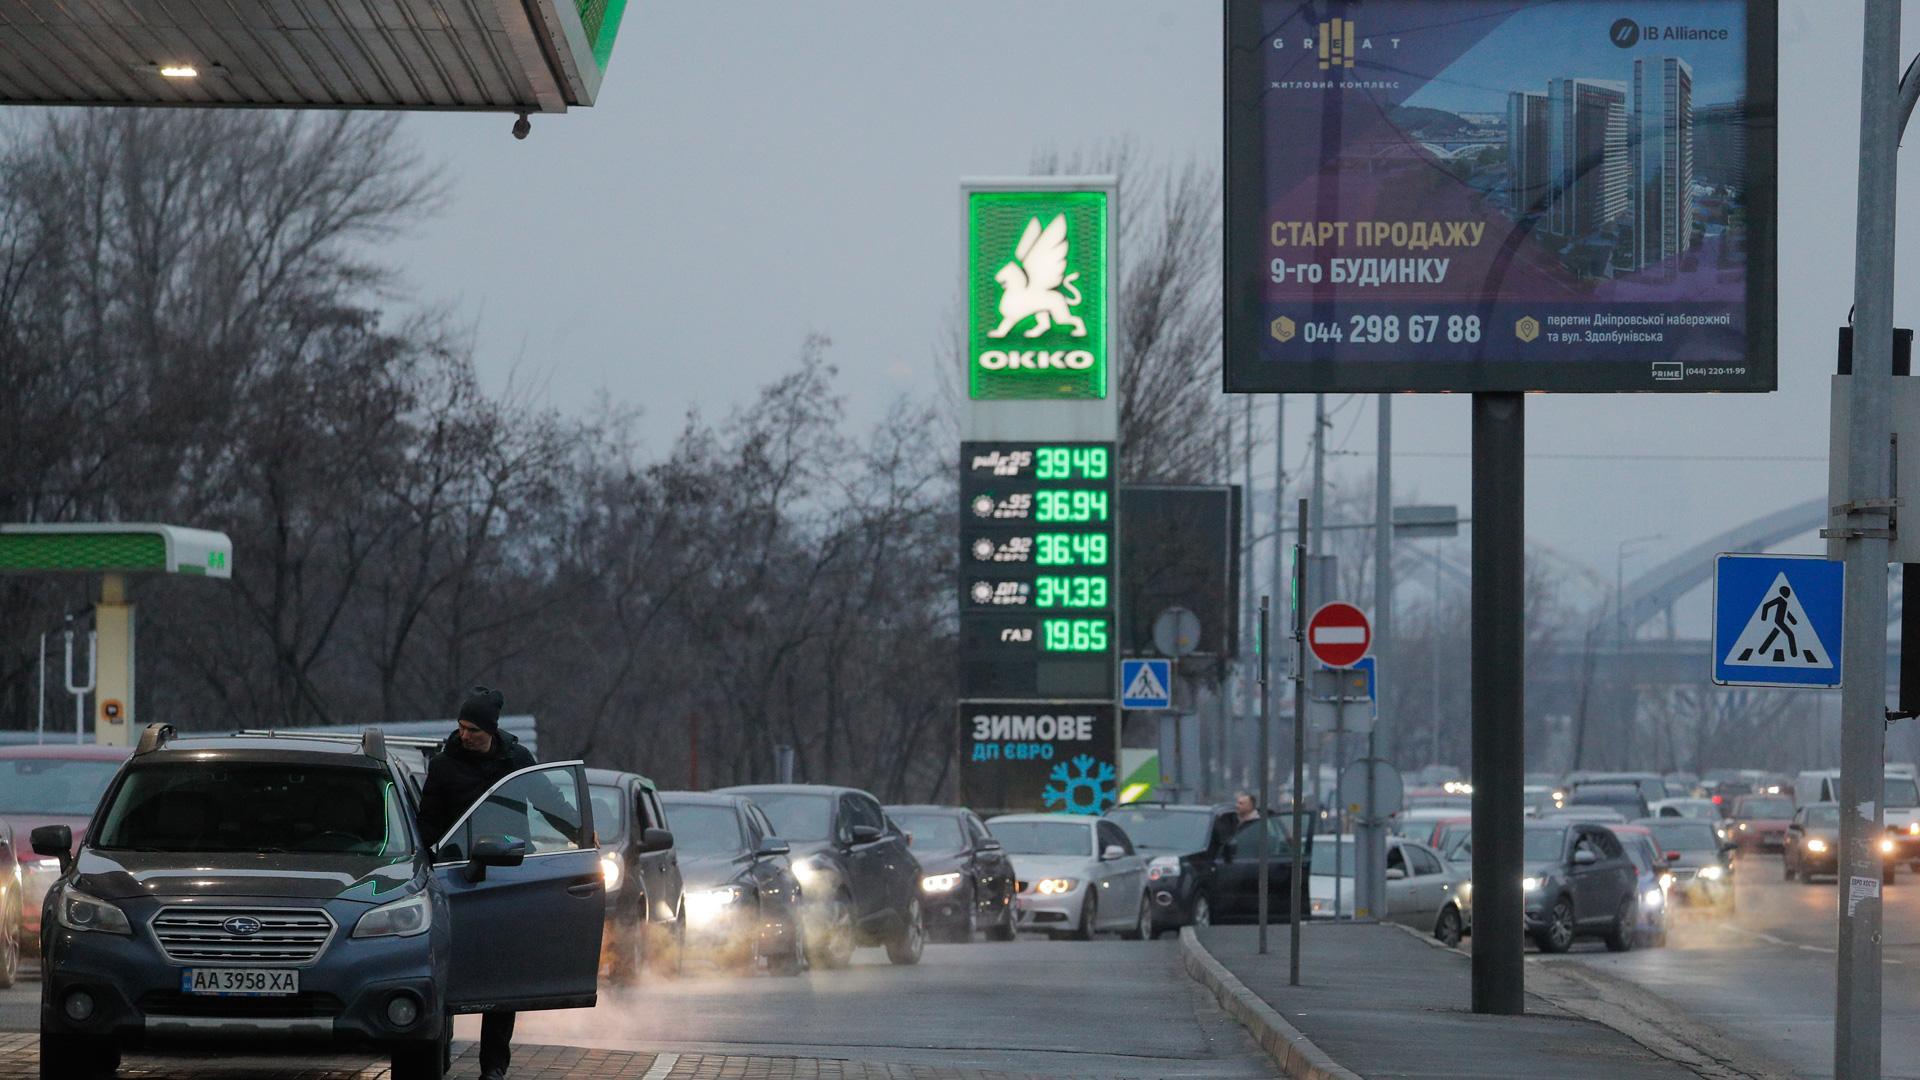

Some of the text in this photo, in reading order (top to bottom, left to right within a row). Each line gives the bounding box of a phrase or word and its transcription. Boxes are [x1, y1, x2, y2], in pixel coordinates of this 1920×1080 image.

[1643, 26, 1729, 40] IB Alliance
[1271, 81, 1399, 89] ЖИТЛОВИЙ КОМПЛЕКС
[1271, 221, 1485, 250] СТАРТ ПРОДАЖУ
[1271, 258, 1449, 287] 9-го БУДИНКУ
[1304, 315, 1481, 343] 044 298 67 88
[1547, 313, 1730, 326] перетин Дніпровської набережної
[1547, 330, 1663, 344] та вул. Здолбунівська
[1686, 367, 1746, 376] (044) 220-11-99
[1036, 491, 1107, 521] 36.94
[1036, 534, 1107, 564] 36.49
[1036, 577, 1107, 607] 34.33
[1001, 629, 1033, 642] ГАЗ
[1044, 620, 1107, 650] 19.65
[972, 715, 1092, 741] ЗИМОВЕ
[972, 743, 1054, 761] ДП ЄВРО
[224, 972, 265, 989] 3958
